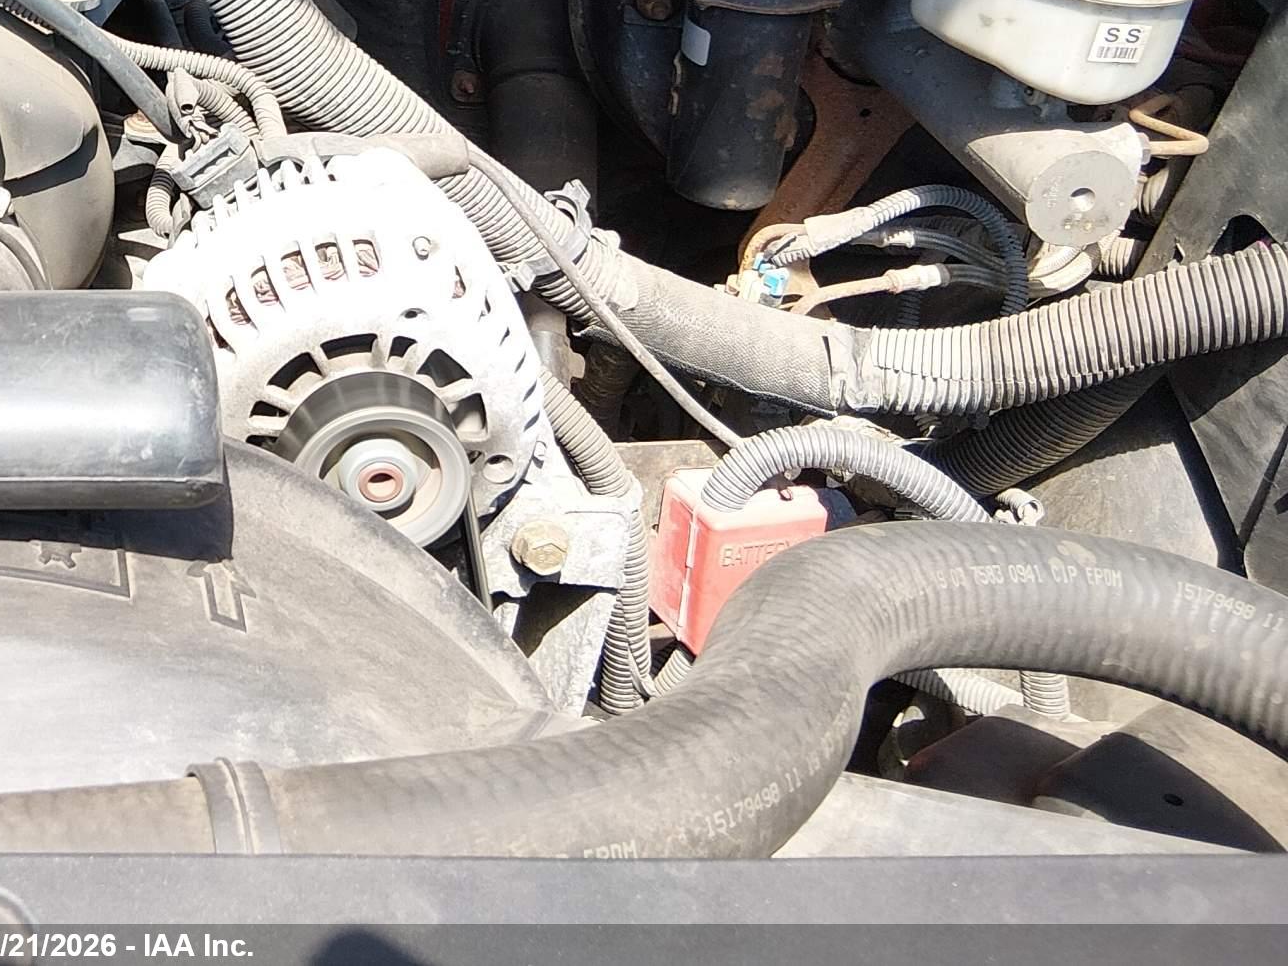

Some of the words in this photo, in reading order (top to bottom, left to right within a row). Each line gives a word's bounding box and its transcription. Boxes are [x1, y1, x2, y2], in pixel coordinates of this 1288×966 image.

[1008, 564, 1043, 583] 0941
[1085, 567, 1123, 587] EPDM
[1176, 581, 1257, 620] 15179498
[1262, 613, 1285, 632] 11
[705, 781, 781, 838] 15179498
[784, 766, 803, 793] 11
